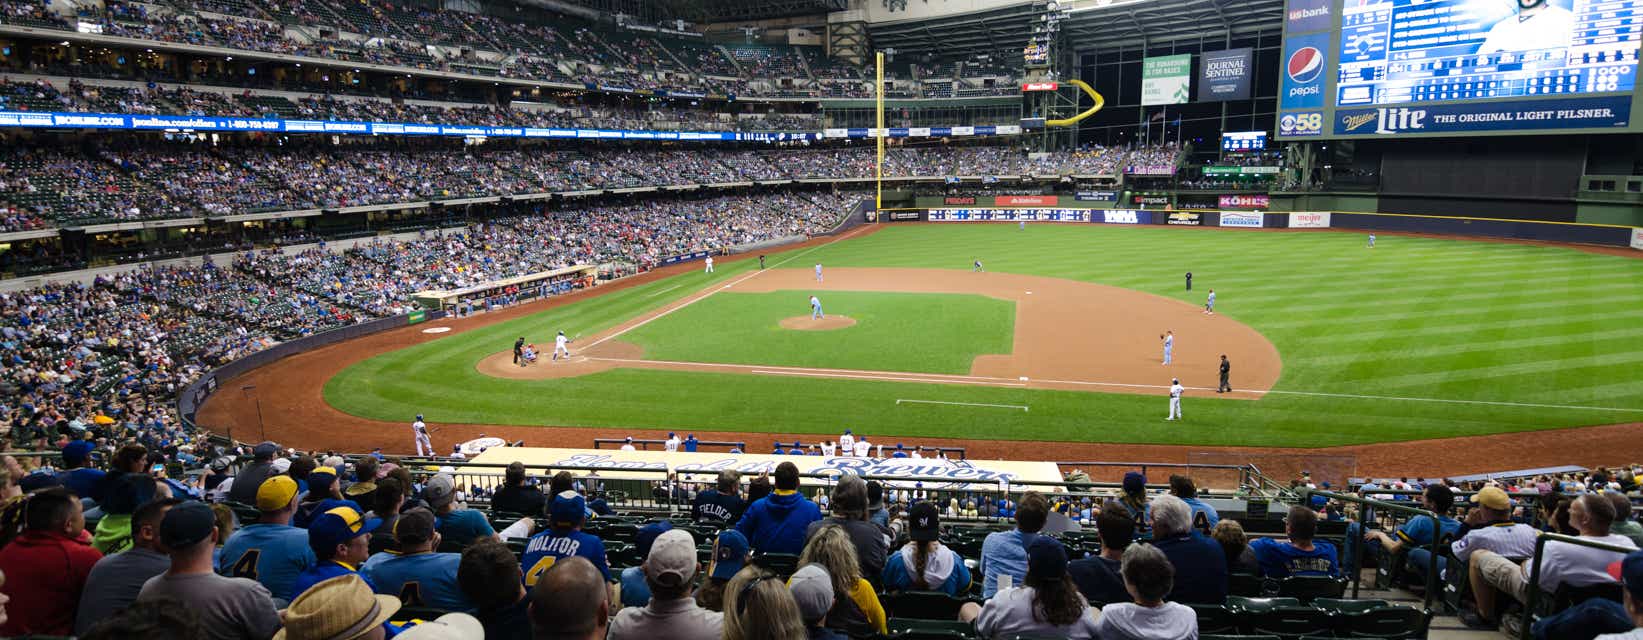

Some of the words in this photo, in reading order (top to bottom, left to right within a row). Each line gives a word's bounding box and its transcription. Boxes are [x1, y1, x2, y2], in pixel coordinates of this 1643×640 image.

[1206, 68, 1245, 78] SENTINEL
[1207, 59, 1245, 72] JOURNAL
[1290, 84, 1319, 97] pepsi
[1296, 113, 1322, 130] 58
[1342, 112, 1377, 130] Miller
[1375, 108, 1426, 134] Lite
[1434, 115, 1456, 123] THE
[1458, 112, 1513, 122] ORIGINAL
[1515, 110, 1554, 121] LIGHT
[1557, 108, 1615, 119] PILSNER.
[526, 535, 580, 557] MOLITOR
[233, 548, 262, 581] 4
